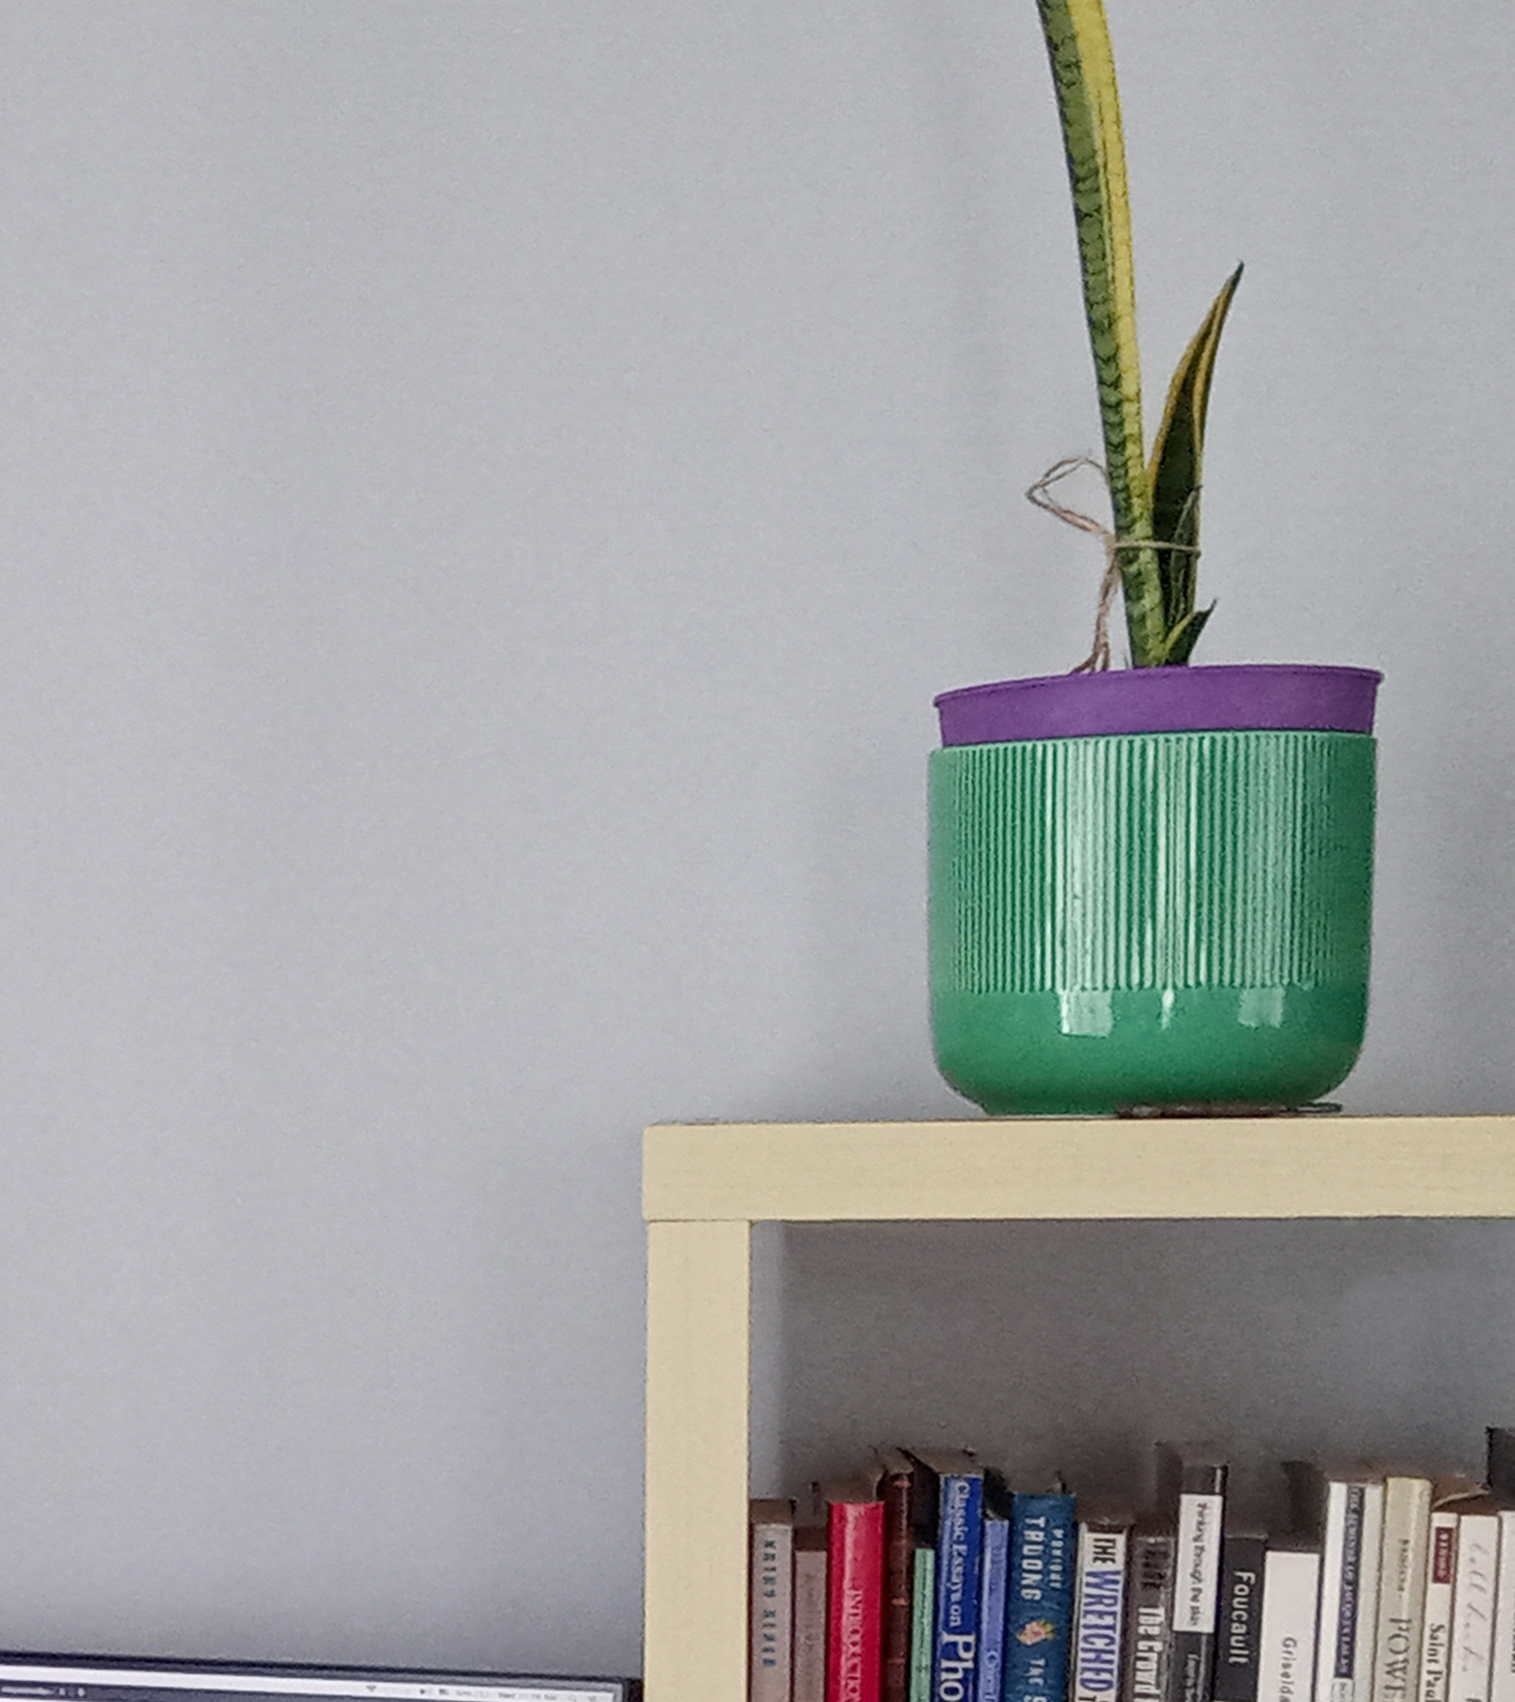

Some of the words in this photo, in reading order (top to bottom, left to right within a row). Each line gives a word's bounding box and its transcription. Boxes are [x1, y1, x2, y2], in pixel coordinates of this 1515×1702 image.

[952, 1479, 970, 1542] Classic
[947, 1544, 968, 1602] Essays
[1020, 1516, 1046, 1601] TRUONG
[1092, 1538, 1117, 1565] THE
[950, 1604, 963, 1627] on
[1137, 1606, 1166, 1635] The
[1190, 1587, 1203, 1603] the
[1228, 1571, 1256, 1664] Foucault
[1079, 1569, 1122, 1692] WRETCHED
[1427, 1623, 1446, 1664] Saint
[1133, 1640, 1164, 1695] Crowd
